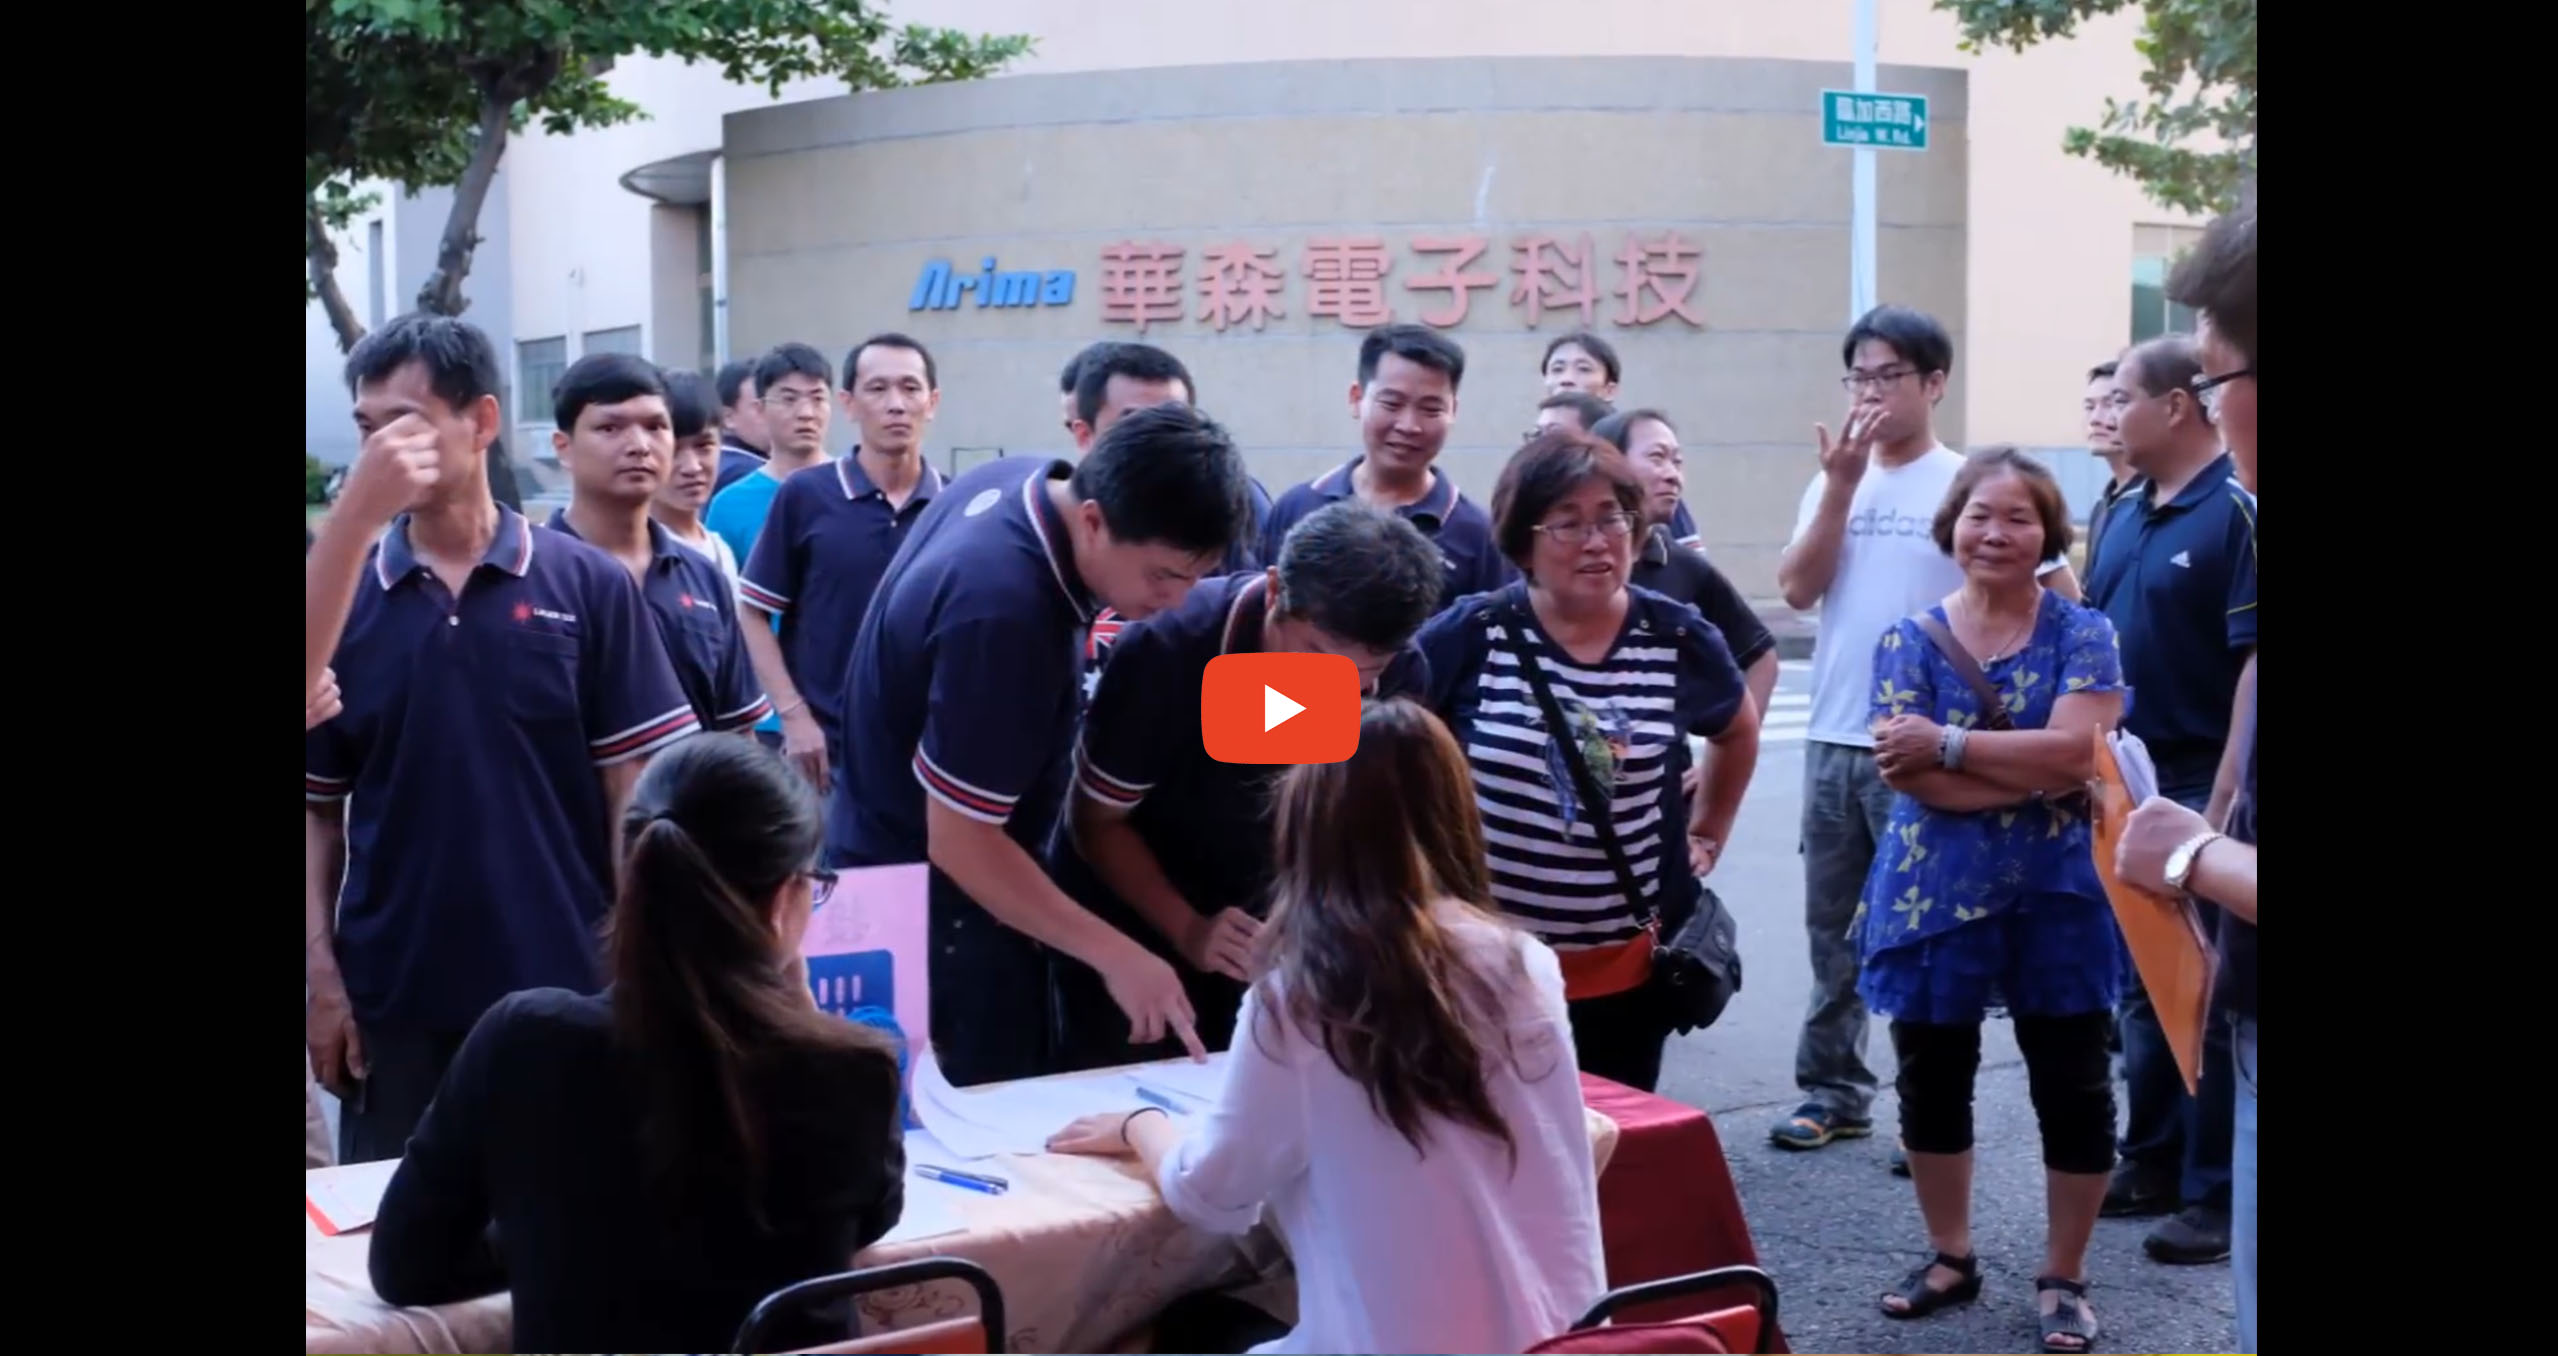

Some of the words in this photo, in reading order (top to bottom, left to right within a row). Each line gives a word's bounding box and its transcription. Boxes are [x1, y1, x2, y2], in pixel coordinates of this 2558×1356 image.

[909, 256, 1075, 311] Arima
[1101, 231, 1708, 334] 華森電子科技
[1848, 507, 1931, 540] didas
